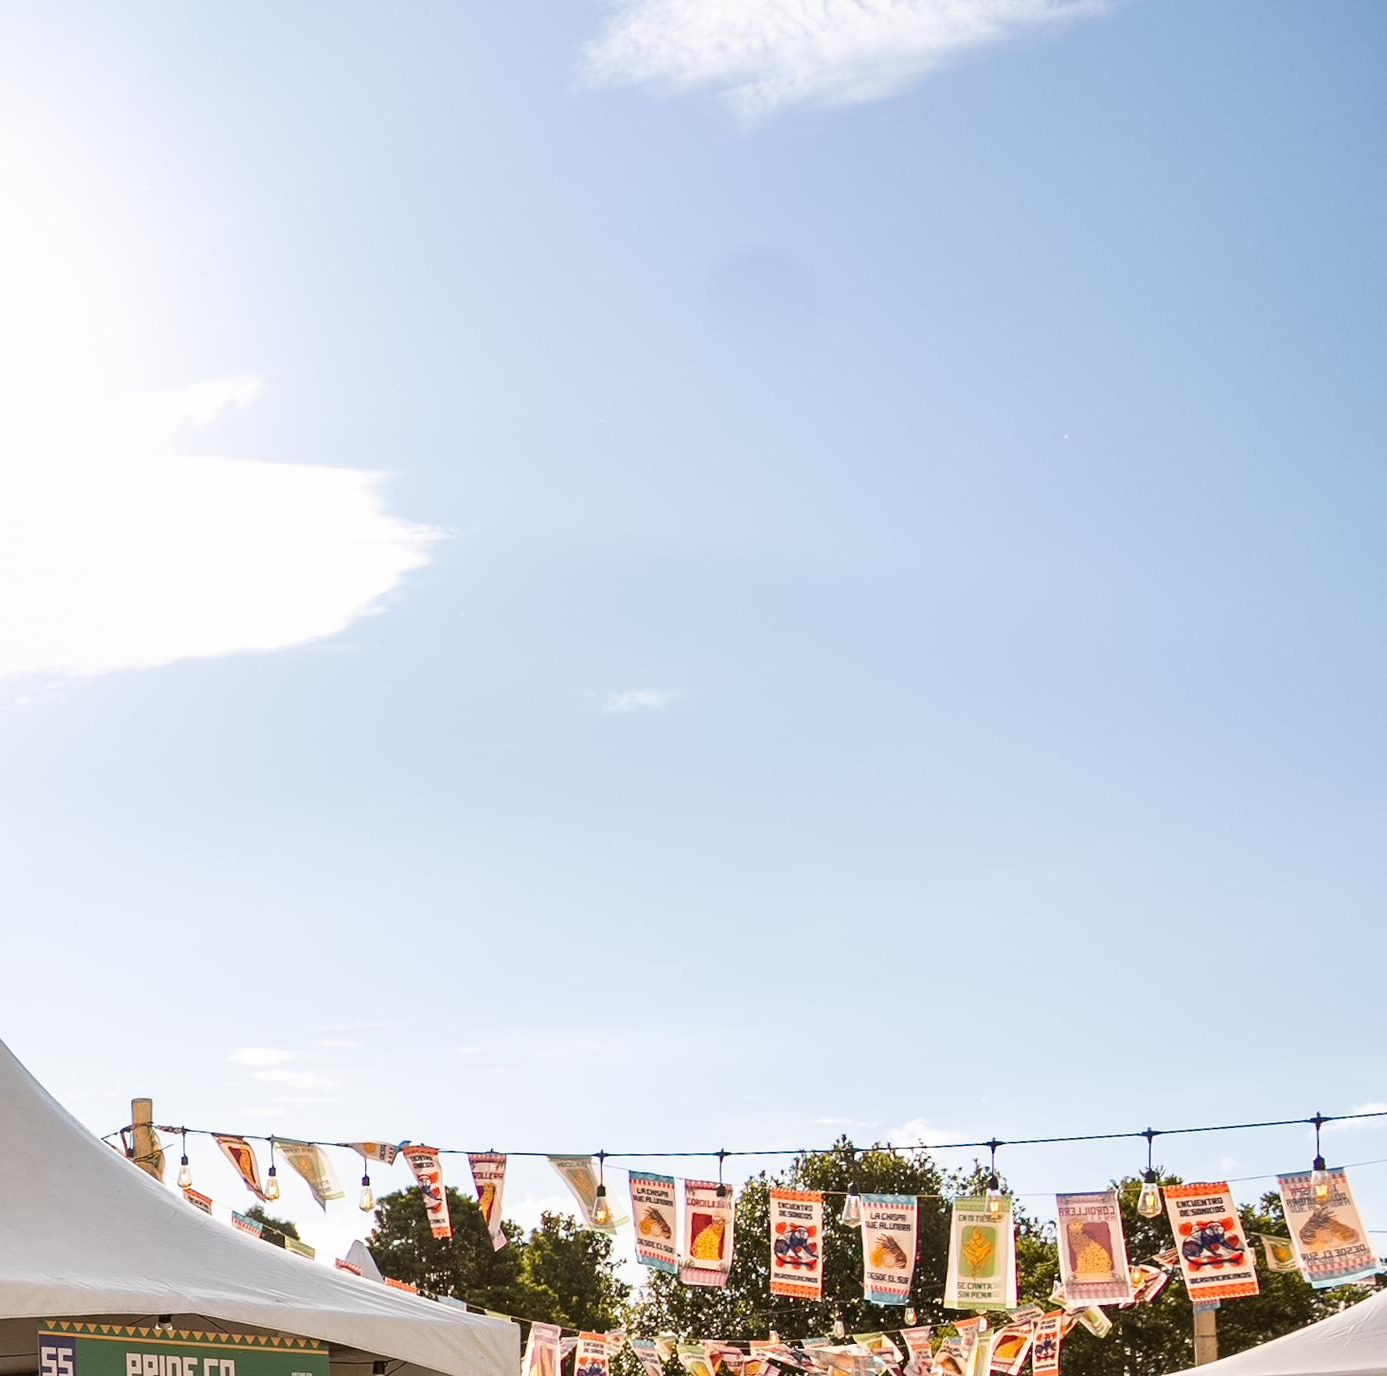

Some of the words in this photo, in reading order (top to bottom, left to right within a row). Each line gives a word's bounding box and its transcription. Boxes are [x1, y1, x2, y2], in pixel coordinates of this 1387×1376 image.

[1176, 1197, 1223, 1208] ENCUENTRO
[870, 1212, 879, 1221] LA
[880, 1213, 907, 1223] CHISPA
[1180, 1208, 1191, 1218] DE
